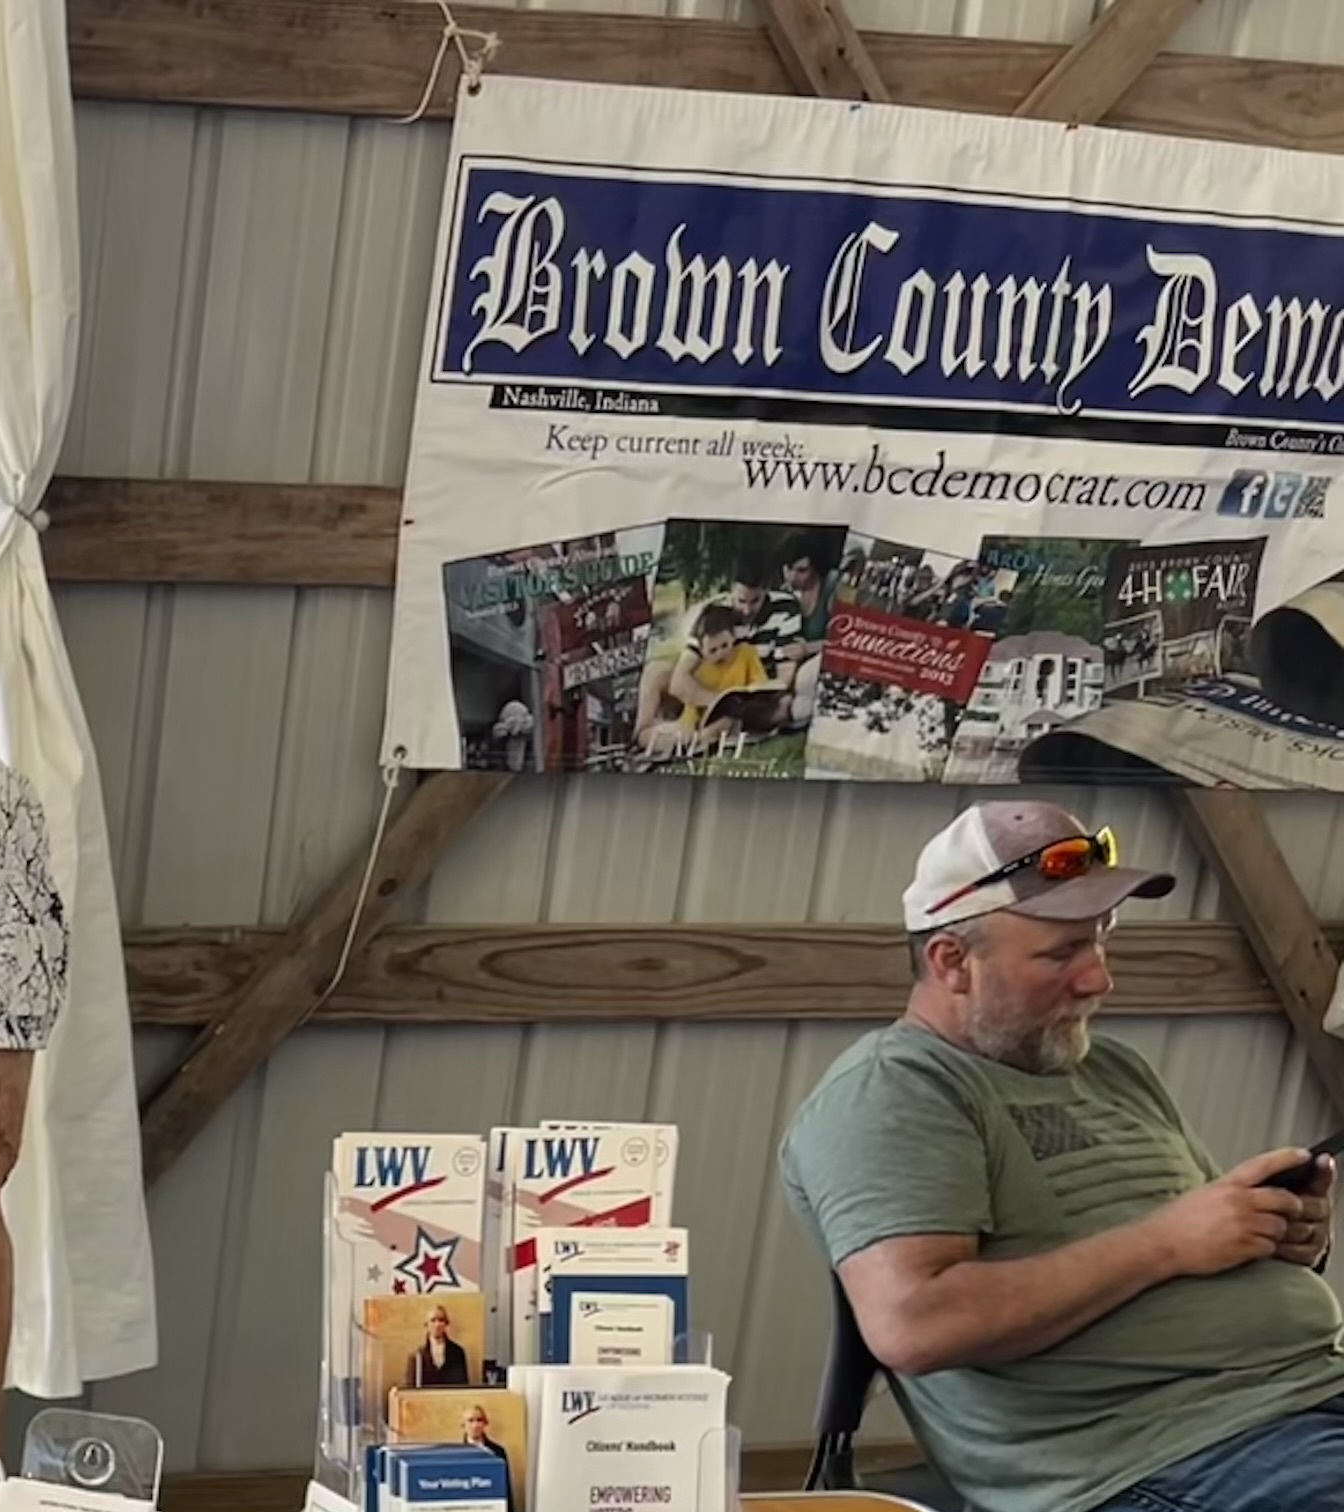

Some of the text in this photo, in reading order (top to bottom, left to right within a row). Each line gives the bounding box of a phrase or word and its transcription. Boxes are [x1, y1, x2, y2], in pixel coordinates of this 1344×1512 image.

[461, 190, 791, 376] Brown
[819, 220, 1112, 415] County
[502, 387, 660, 414] Nashville, Indiana
[544, 423, 804, 460] Keep current all week:
[743, 444, 1208, 512] www.bcdemocrat.com
[1192, 562, 1249, 601] FAIR
[825, 613, 966, 671] Connections
[354, 1145, 433, 1189] LWV
[524, 1137, 601, 1180] LWV
[561, 1390, 596, 1413] LWV
[625, 1439, 677, 1452] Handbook
[417, 1476, 492, 1490] Your Voting Plan
[589, 1485, 672, 1504] EMPOWERING
